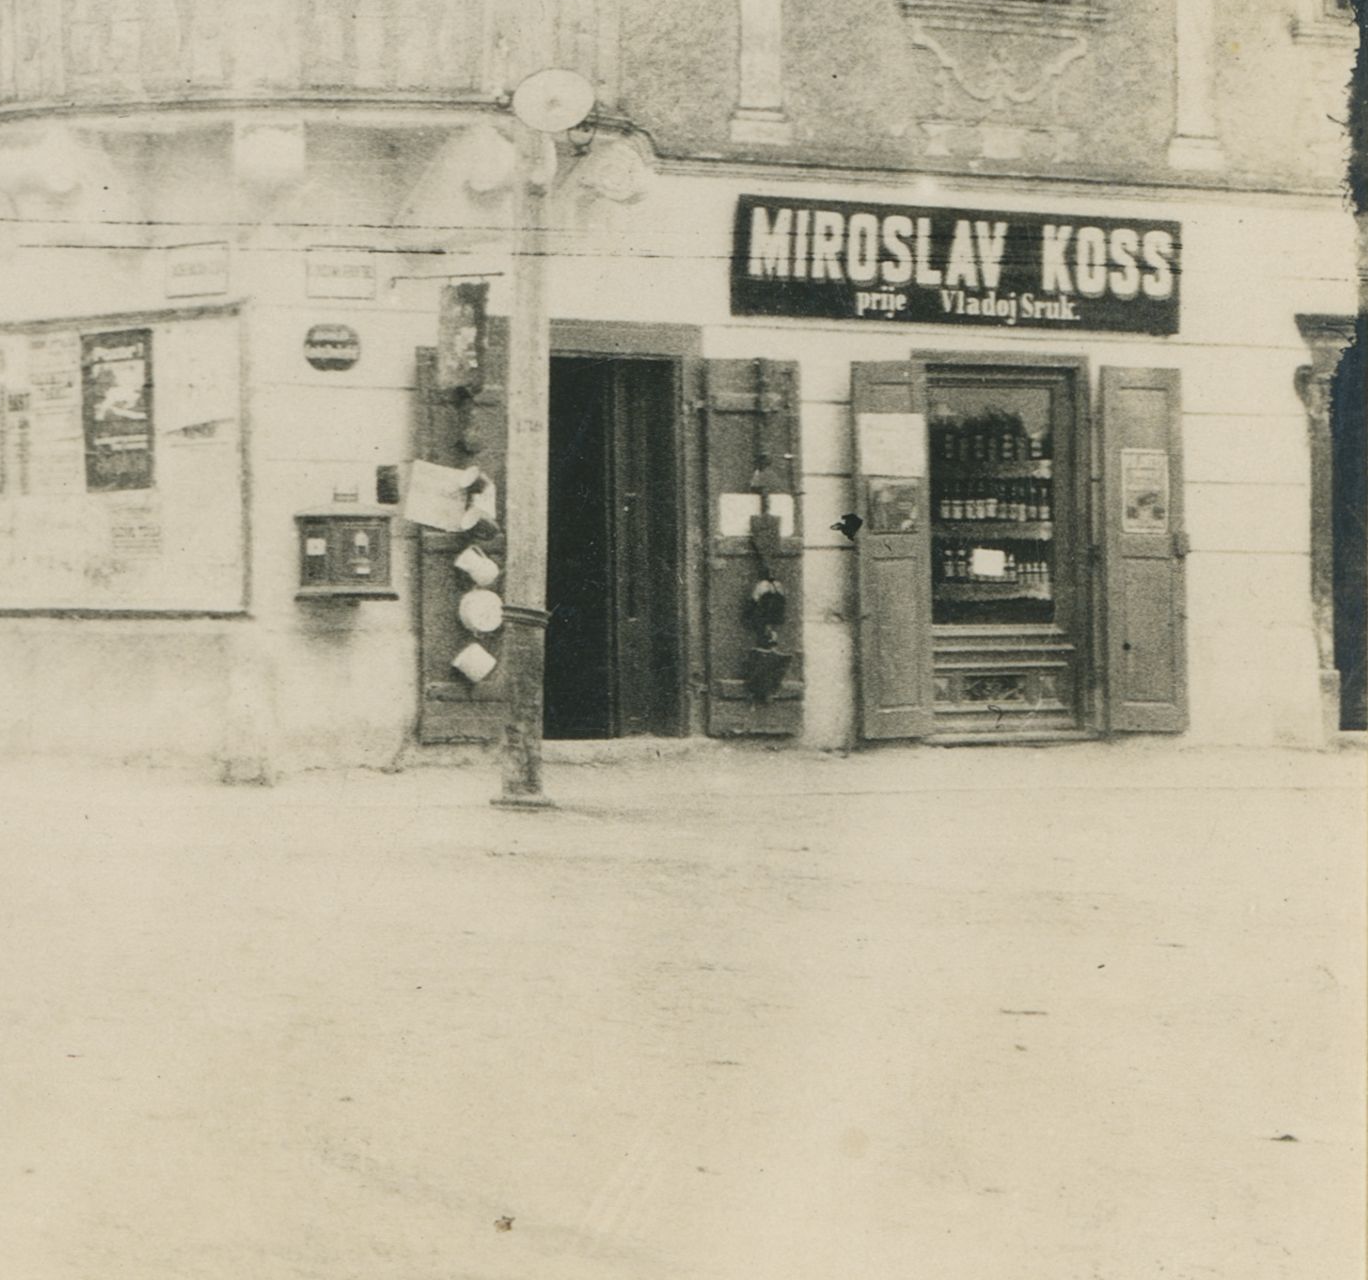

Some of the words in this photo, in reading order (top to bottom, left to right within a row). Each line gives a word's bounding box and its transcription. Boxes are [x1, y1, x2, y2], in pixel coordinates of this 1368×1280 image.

[748, 206, 1008, 290] MIROSLAV
[1042, 224, 1173, 298] KOSS
[856, 285, 908, 319] prije
[941, 289, 1016, 325] Vladoj
[1021, 292, 1081, 320] Sruk.
